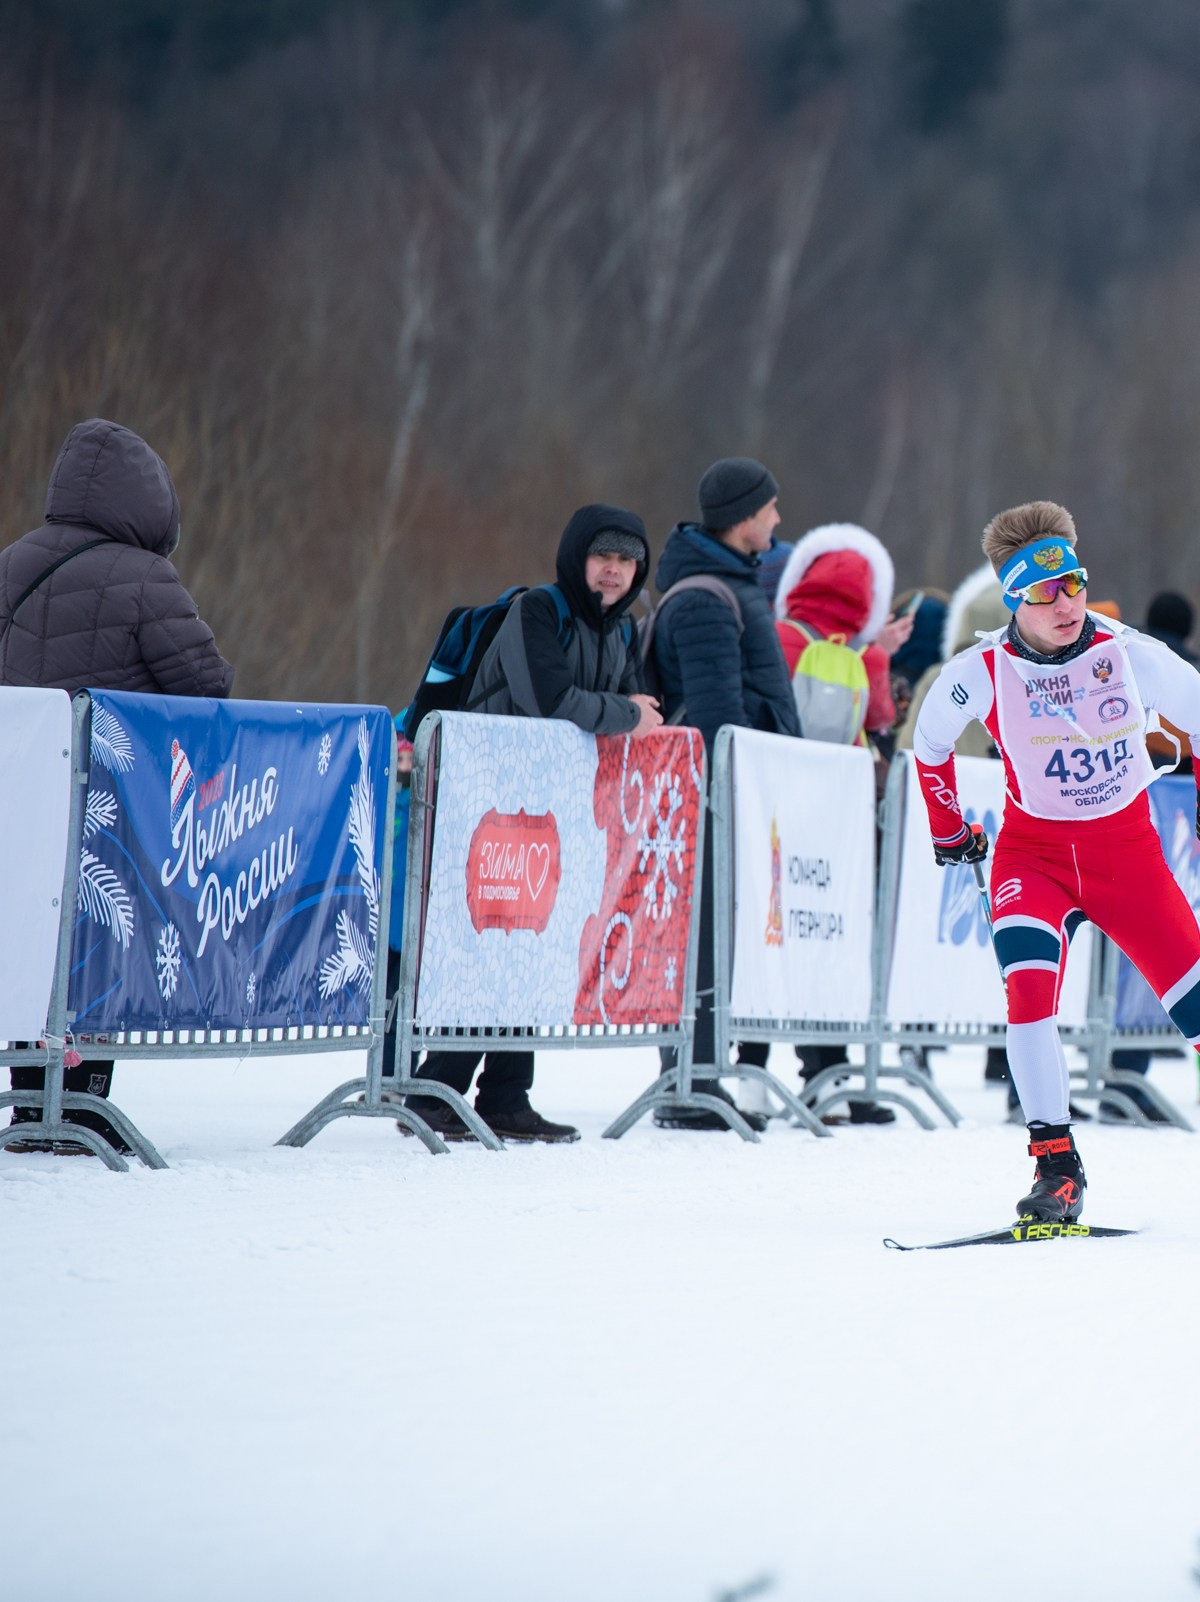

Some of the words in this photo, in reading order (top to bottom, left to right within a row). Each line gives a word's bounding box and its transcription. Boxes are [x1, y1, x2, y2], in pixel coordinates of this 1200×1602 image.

[198, 771, 225, 811] 2023
[1060, 764, 1129, 798] МОСКОВСКАЯ
[1074, 784, 1122, 807] ОБЛАСТЬ
[160, 763, 279, 888] Лыжня
[479, 841, 525, 881] ЗИМА
[196, 826, 298, 958] России
[1026, 1223, 1090, 1240] FISCHER
